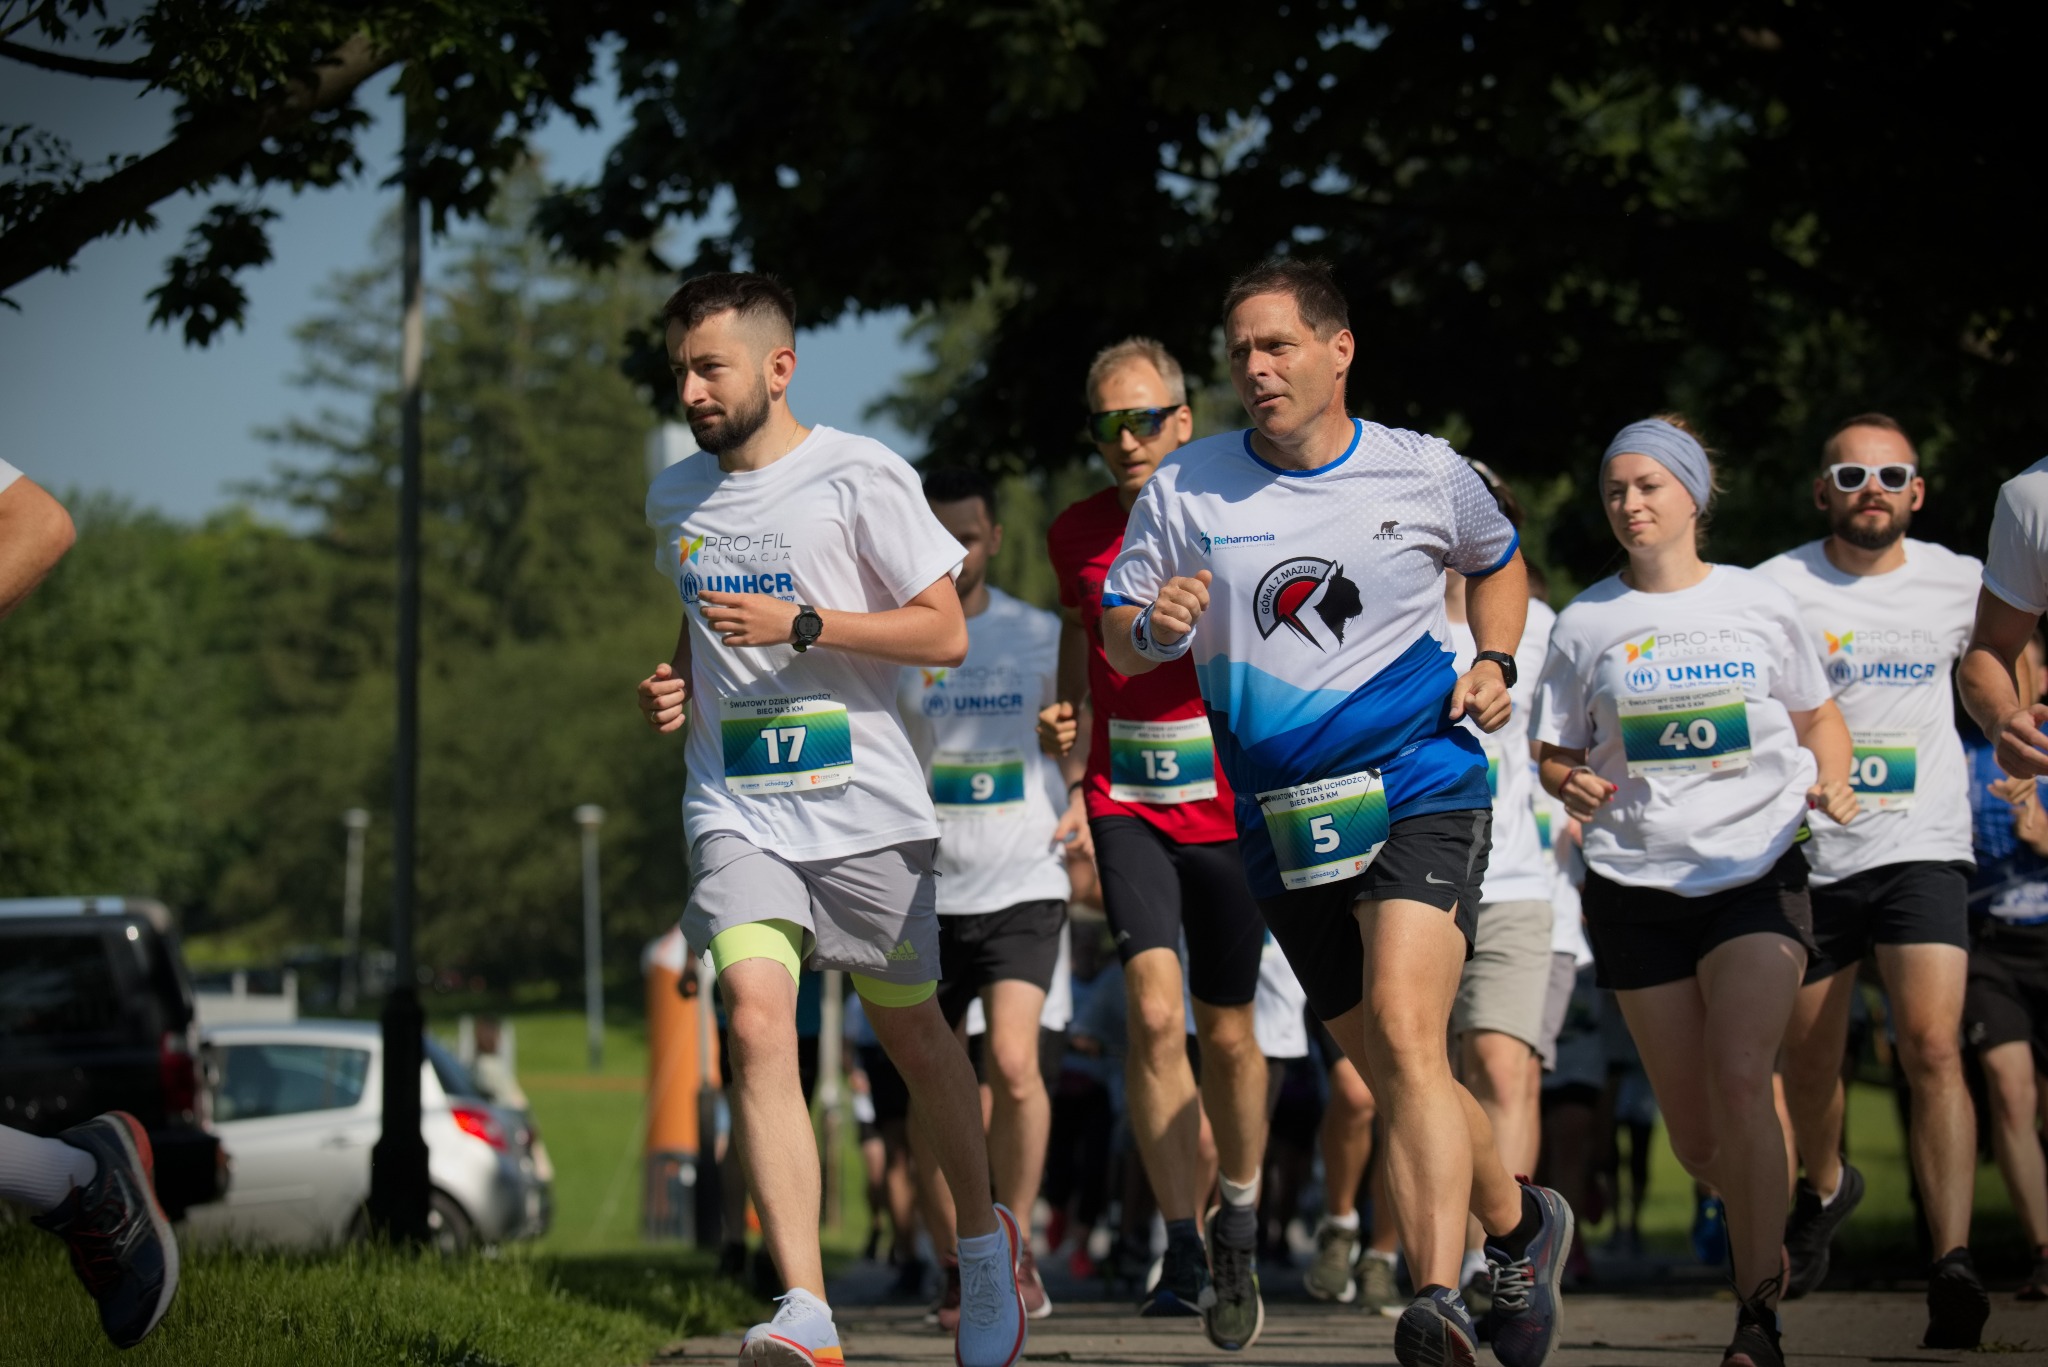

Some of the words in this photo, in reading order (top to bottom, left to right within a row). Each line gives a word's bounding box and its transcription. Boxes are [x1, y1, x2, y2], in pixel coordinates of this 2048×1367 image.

[704, 532, 792, 552] PRO-FIL
[1214, 531, 1275, 545] Reharmonia
[1373, 533, 1404, 541] ATTIQ
[702, 551, 791, 565] FUNDACJA
[707, 572, 794, 594] UNHCR
[1261, 582, 1278, 615] GÓRAL
[1273, 576, 1282, 586] Z
[1280, 565, 1318, 580] MAZUR
[1656, 629, 1751, 649] PRO-FIL
[1855, 629, 1939, 645] PRO-FIL
[1658, 644, 1754, 658] FUNDACJA
[1666, 661, 1756, 682] UNHCR
[1863, 663, 1936, 680] UNHCR
[729, 699, 767, 709] ŚWIATOWY
[768, 695, 790, 706] DZIEŃ
[790, 692, 832, 704] UCHODŹCY
[756, 706, 774, 715] BIEG
[774, 705, 785, 714] NA
[791, 705, 804, 713] KM
[954, 693, 1023, 711] UNHCR
[1658, 718, 1718, 751] 40
[760, 726, 807, 764] 17
[1141, 749, 1180, 781] 13
[1849, 755, 1889, 787] 20
[970, 772, 995, 801] 9
[1299, 784, 1323, 797] DZIEŃ
[1324, 775, 1369, 790] UCHODŹCY
[1289, 798, 1307, 808] BIEG
[1307, 795, 1319, 804] NA
[1326, 790, 1339, 799] KM
[1309, 814, 1341, 854] 5
